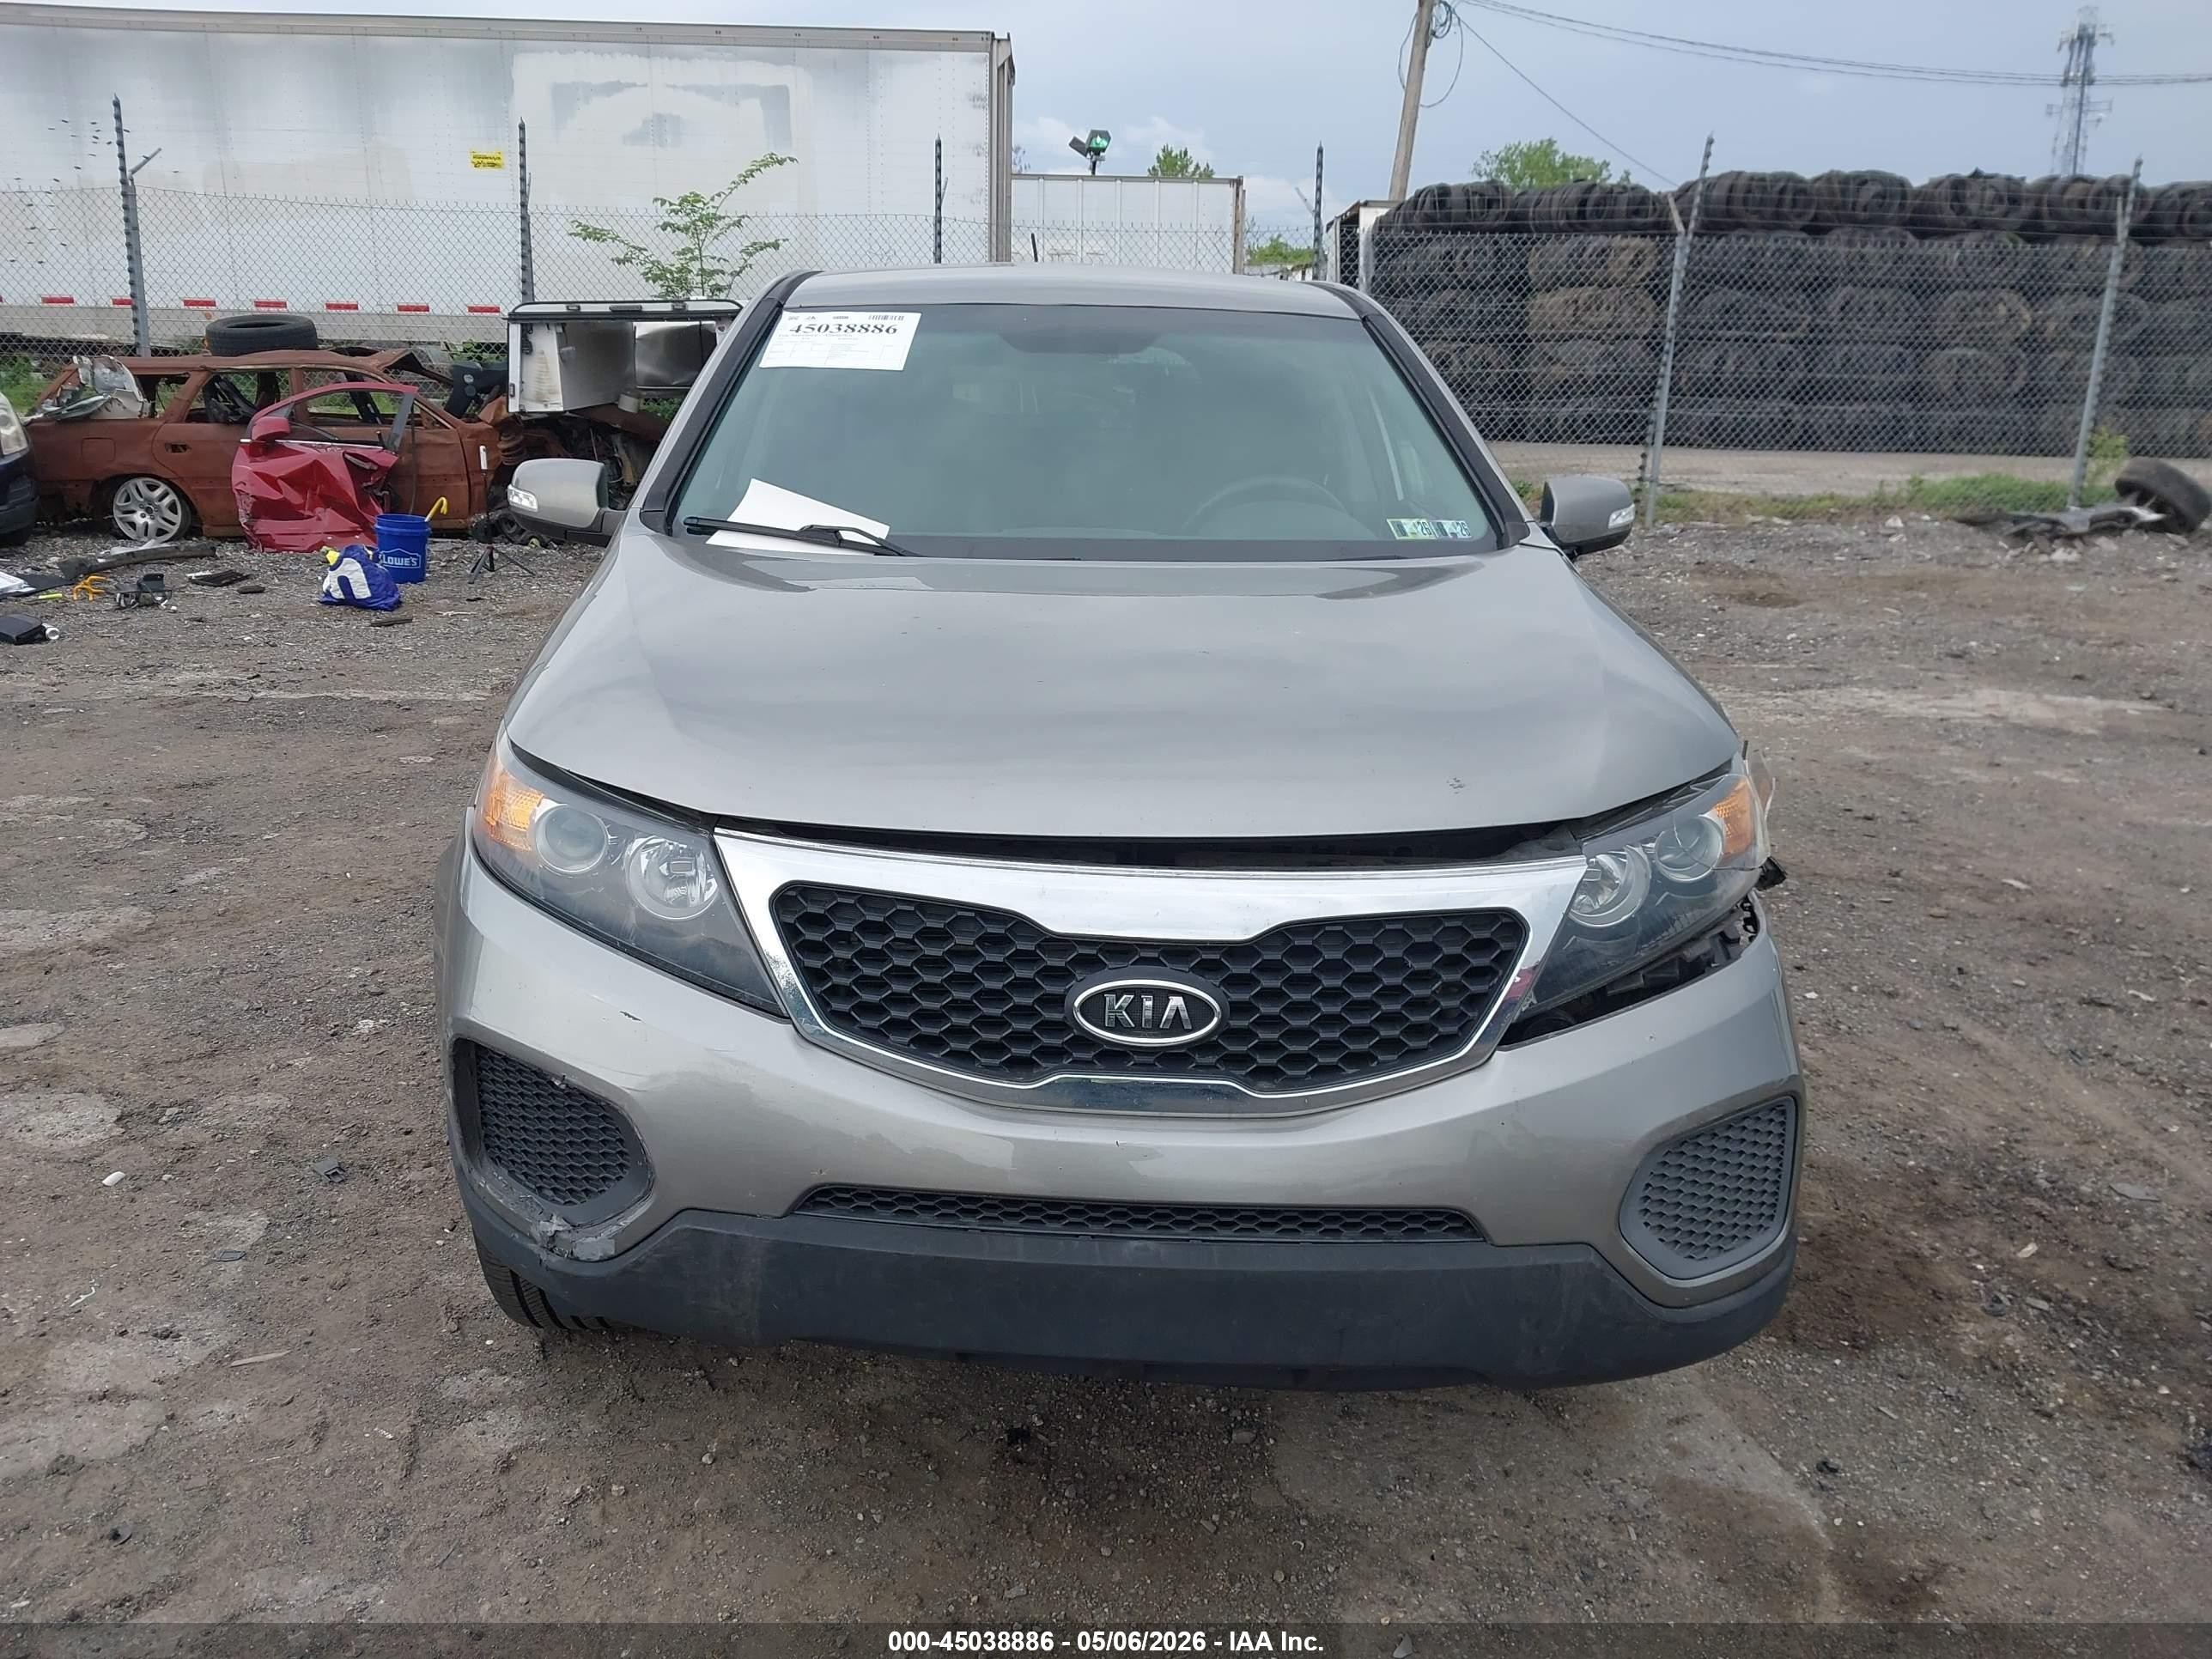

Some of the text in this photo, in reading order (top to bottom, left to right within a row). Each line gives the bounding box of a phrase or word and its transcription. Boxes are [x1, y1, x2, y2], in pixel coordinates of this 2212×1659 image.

[789, 323, 898, 335] 45038886
[382, 554, 418, 567] LOWE'S
[1103, 994, 1193, 1030] KIA
